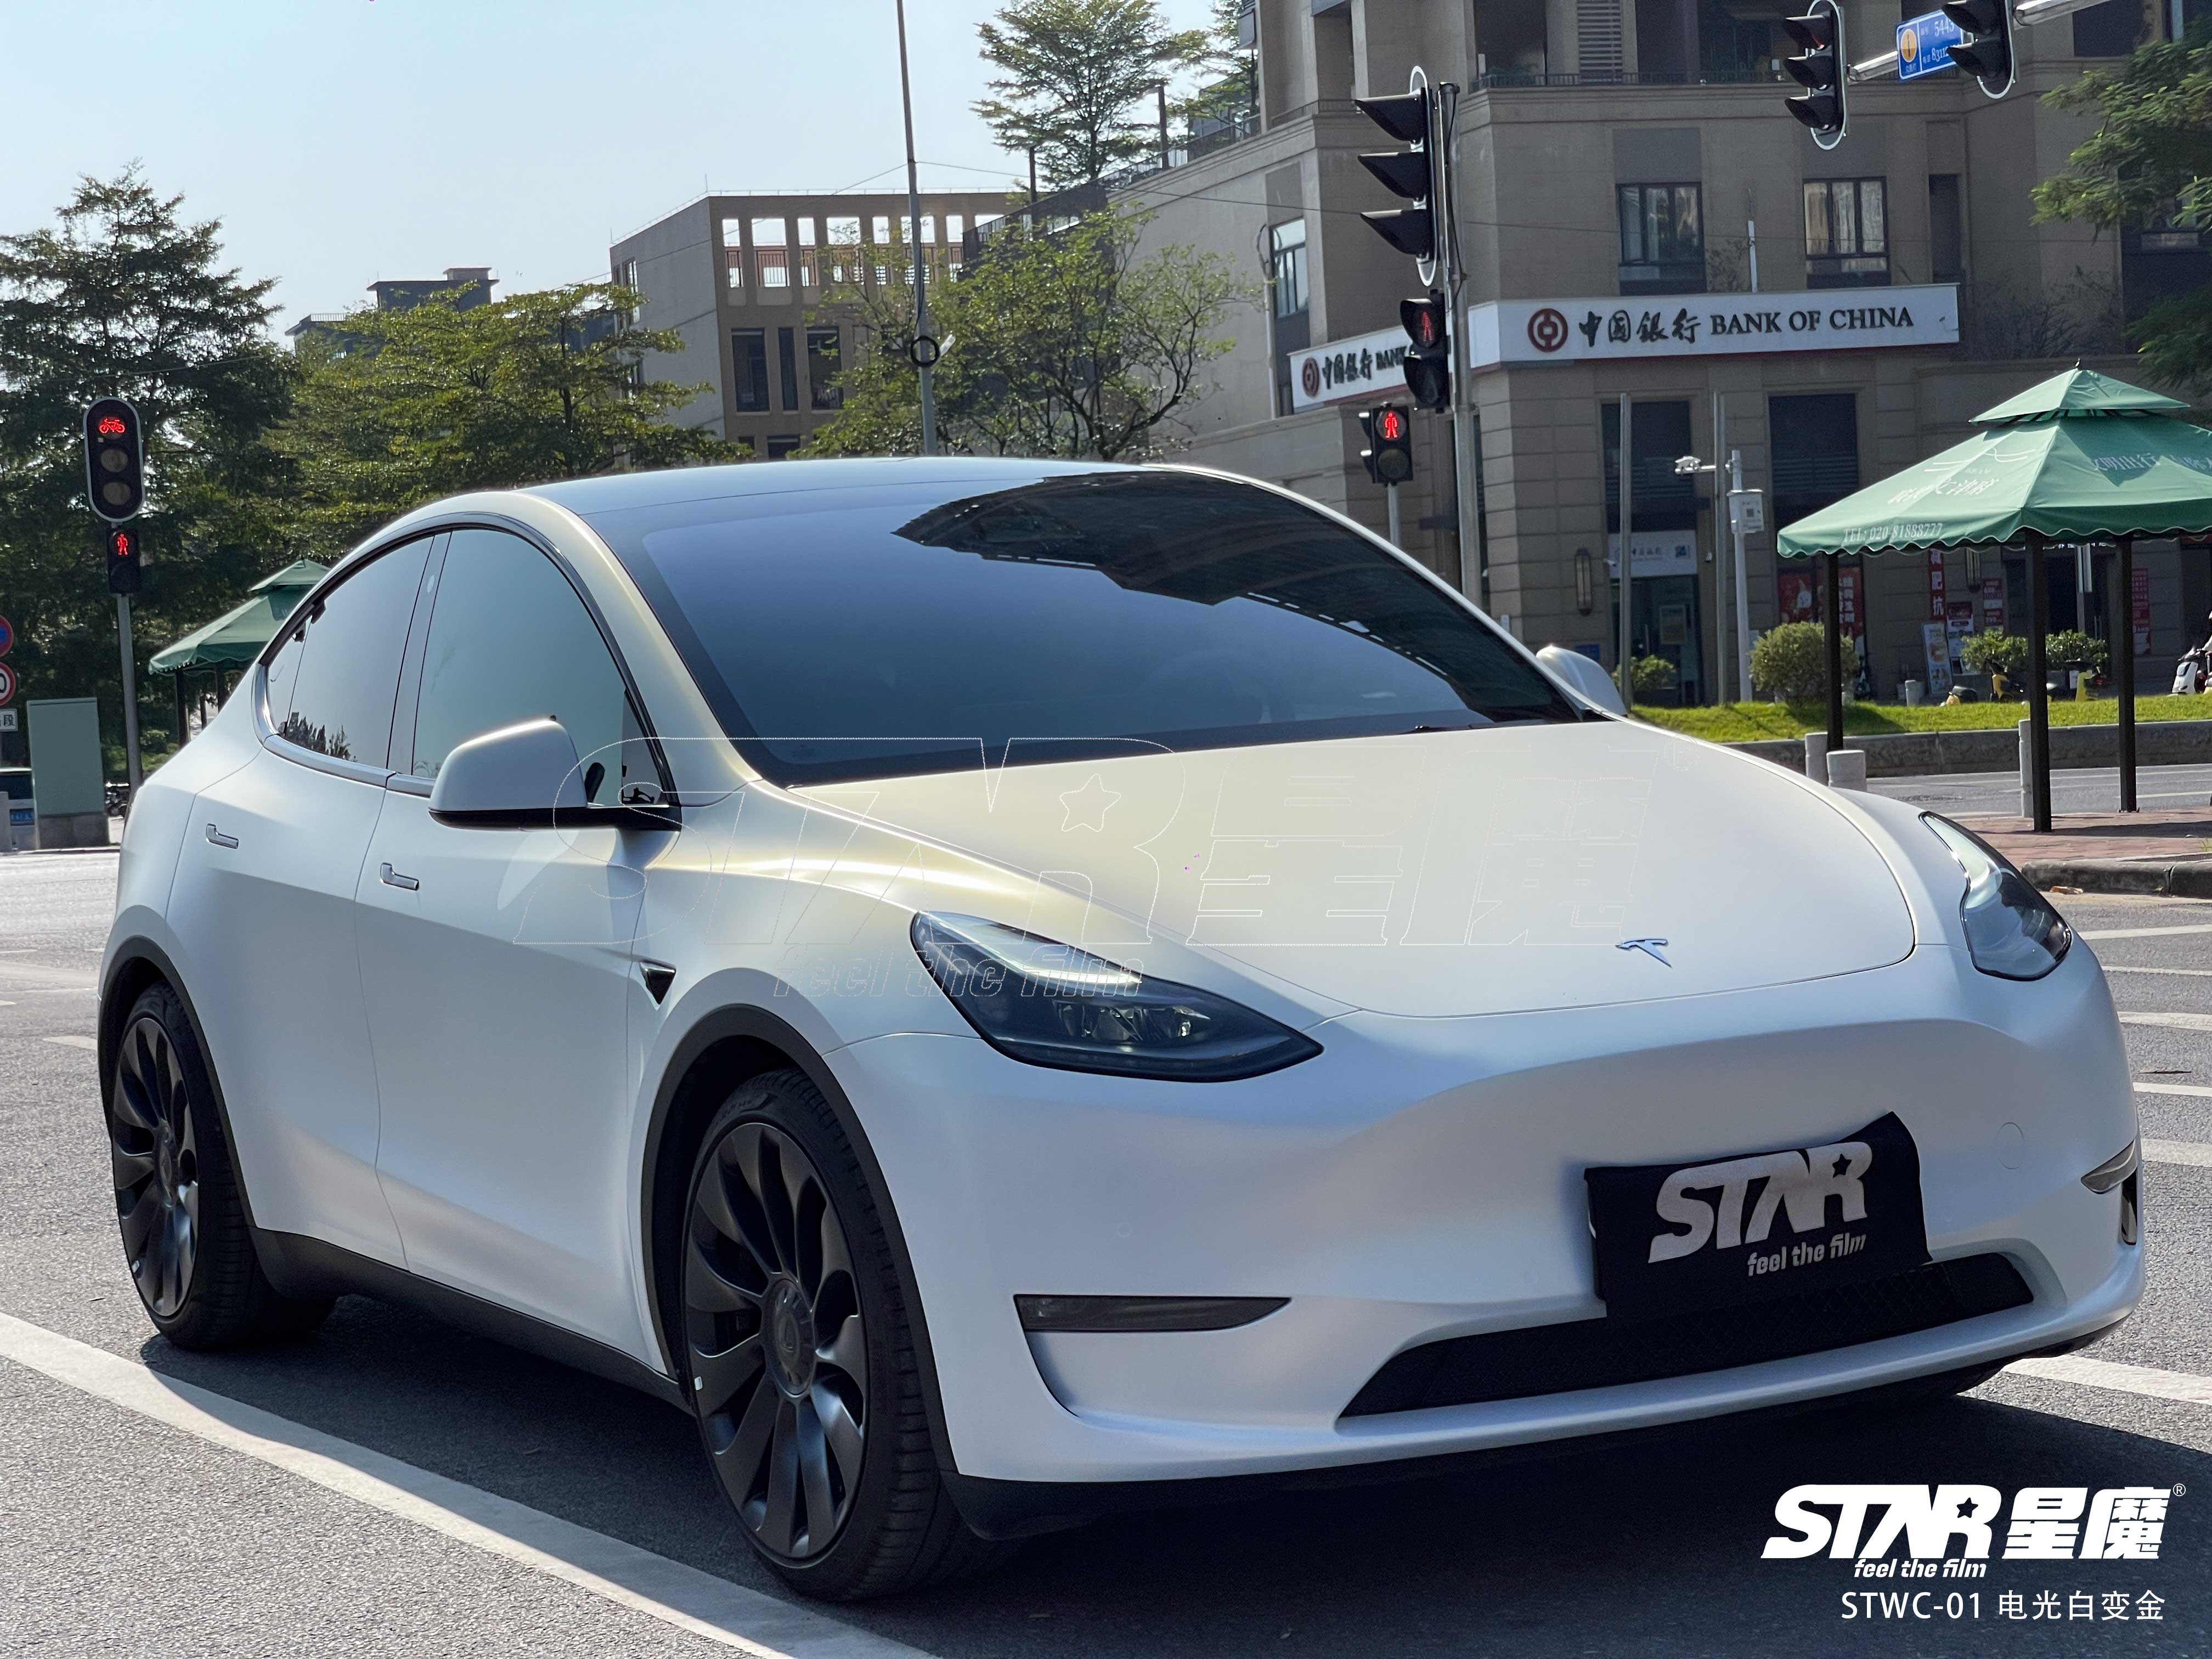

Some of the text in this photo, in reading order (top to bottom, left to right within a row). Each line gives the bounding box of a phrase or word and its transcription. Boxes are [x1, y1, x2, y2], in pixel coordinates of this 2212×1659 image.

[1710, 312, 1782, 335] BANK
[1789, 311, 1821, 331] OF
[1830, 307, 1914, 330] CHINA
[1843, 523, 1943, 542] TEL: 020-81888777
[0, 714, 14, 726] 段
[1649, 1142, 1872, 1263] STAR
[1747, 1232, 1866, 1277] feel the film
